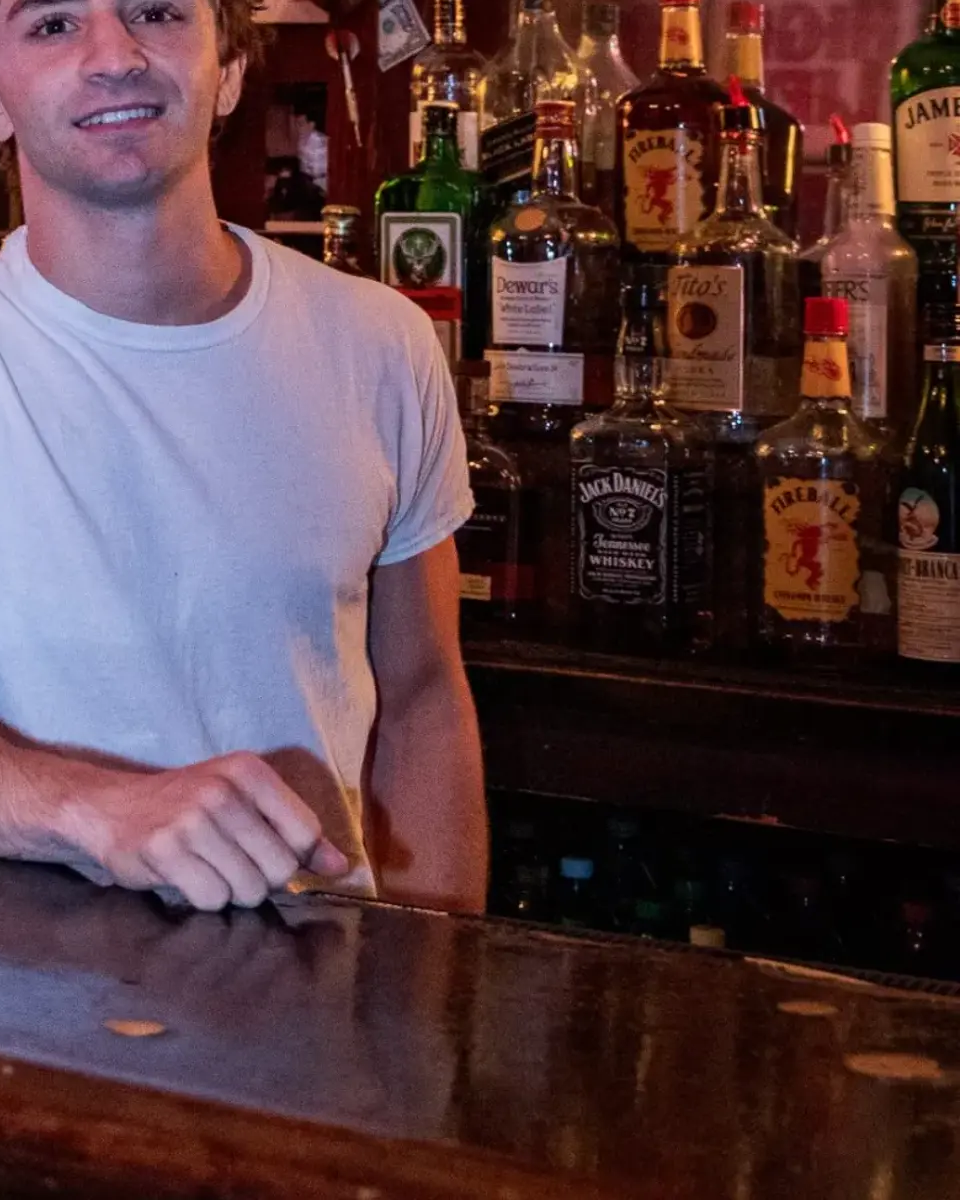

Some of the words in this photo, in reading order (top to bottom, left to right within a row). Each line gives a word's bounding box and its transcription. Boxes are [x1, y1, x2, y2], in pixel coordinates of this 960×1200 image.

[497, 276, 559, 294] Dewar's
[673, 273, 727, 297] Tito's
[579, 477, 613, 504] JACK
[613, 472, 668, 509] DANIEL'S
[589, 554, 655, 570] WHISKEY
